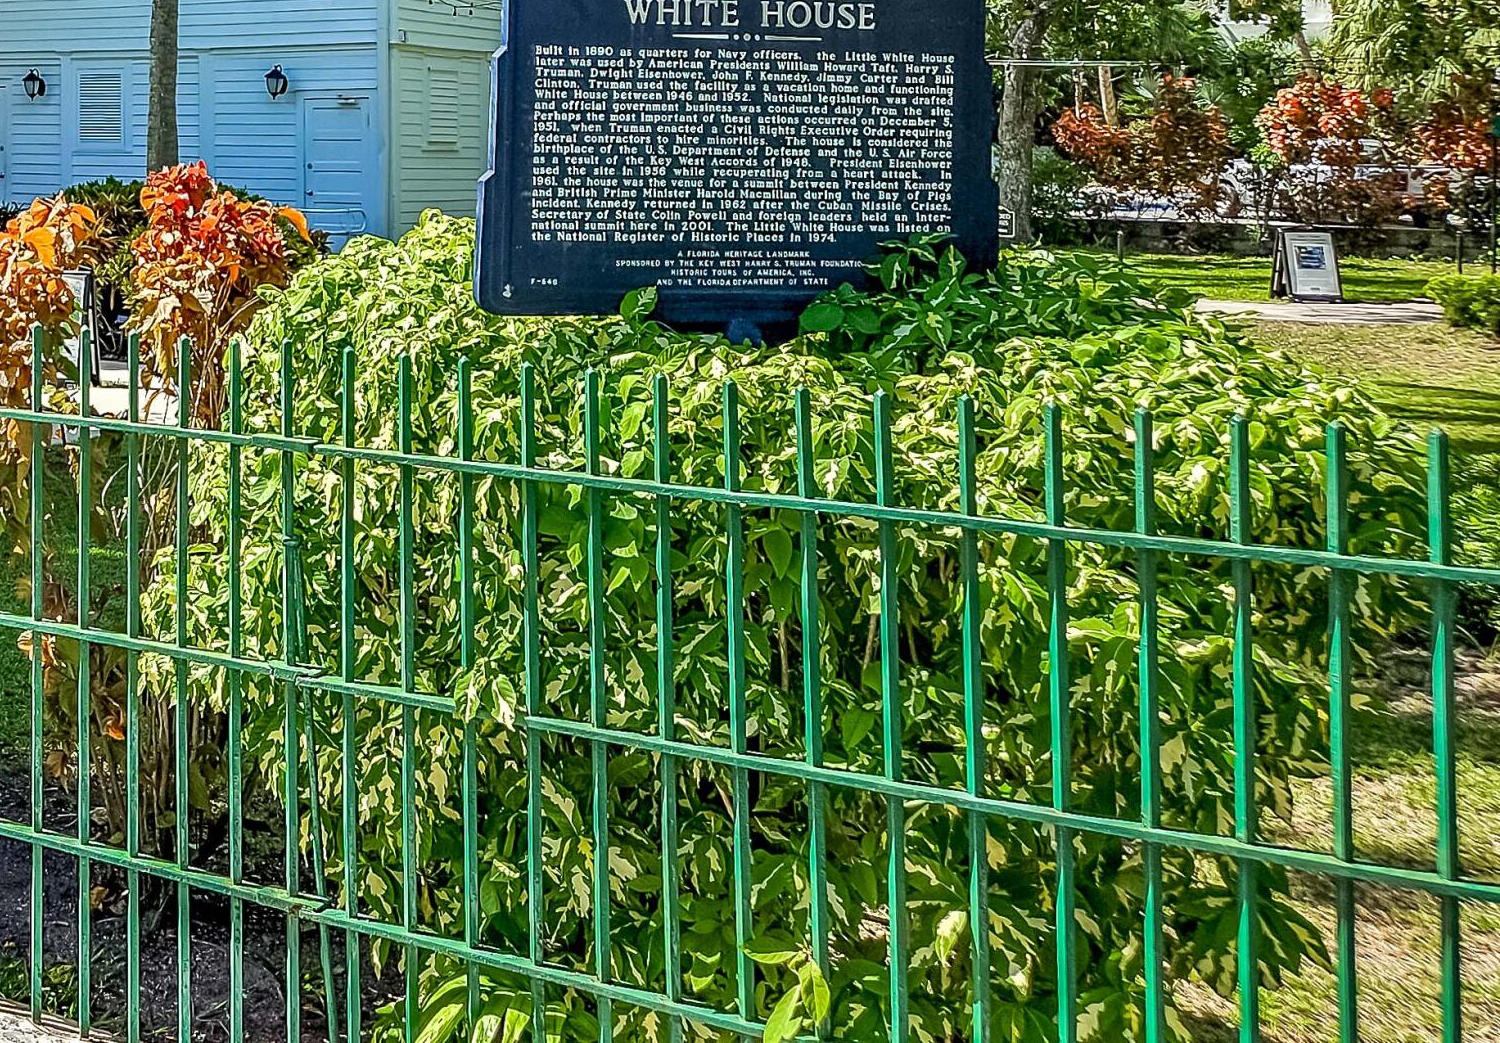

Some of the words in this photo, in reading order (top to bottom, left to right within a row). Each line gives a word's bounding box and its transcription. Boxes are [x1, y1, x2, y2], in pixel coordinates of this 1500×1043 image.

[760, 0, 876, 30] HOUSE
[588, 80, 632, 90] Truman
[636, 80, 663, 90] used
[669, 81, 687, 90] the
[694, 81, 738, 93] facility
[762, 84, 769, 92] a
[776, 82, 826, 92] vacation
[830, 83, 858, 93] home
[864, 84, 884, 93] and
[890, 84, 953, 96] functioning
[534, 90, 567, 99] White
[573, 90, 608, 100] House
[612, 91, 662, 101] between
[666, 92, 692, 101] 1946
[698, 92, 717, 102] and
[763, 93, 811, 103] National
[818, 94, 878, 106] legislation
[885, 97, 906, 105] was
[911, 95, 953, 105] drafted
[534, 100, 555, 110] and
[561, 101, 606, 111] official
[612, 101, 678, 114] government
[685, 103, 732, 113] business
[767, 104, 827, 114] conducted
[834, 105, 863, 117] daily
[871, 106, 897, 116] from
[904, 106, 922, 116] the
[533, 133, 576, 143] federal
[583, 134, 650, 144] contractors
[656, 134, 668, 144] to
[675, 135, 699, 144] hire
[785, 136, 806, 146] The
[812, 137, 844, 146] house
[852, 137, 861, 147] is
[867, 137, 928, 147] considered
[934, 138, 952, 148] the
[531, 209, 592, 221] Secretary
[596, 210, 609, 219] of
[614, 210, 645, 220] State
[651, 210, 680, 220] Colin
[687, 210, 726, 220] Powell
[732, 211, 752, 220] and
[758, 211, 801, 223] foreign
[808, 211, 852, 221] leaders
[861, 212, 886, 221] held
[915, 212, 951, 222] inter-
[531, 231, 551, 241] the
[556, 231, 606, 241] National
[614, 232, 664, 243] Register
[671, 232, 684, 241] of
[691, 232, 739, 241] Historic
[746, 232, 783, 242] Places
[790, 232, 800, 242] in
[687, 250, 720, 258] FLORIDA
